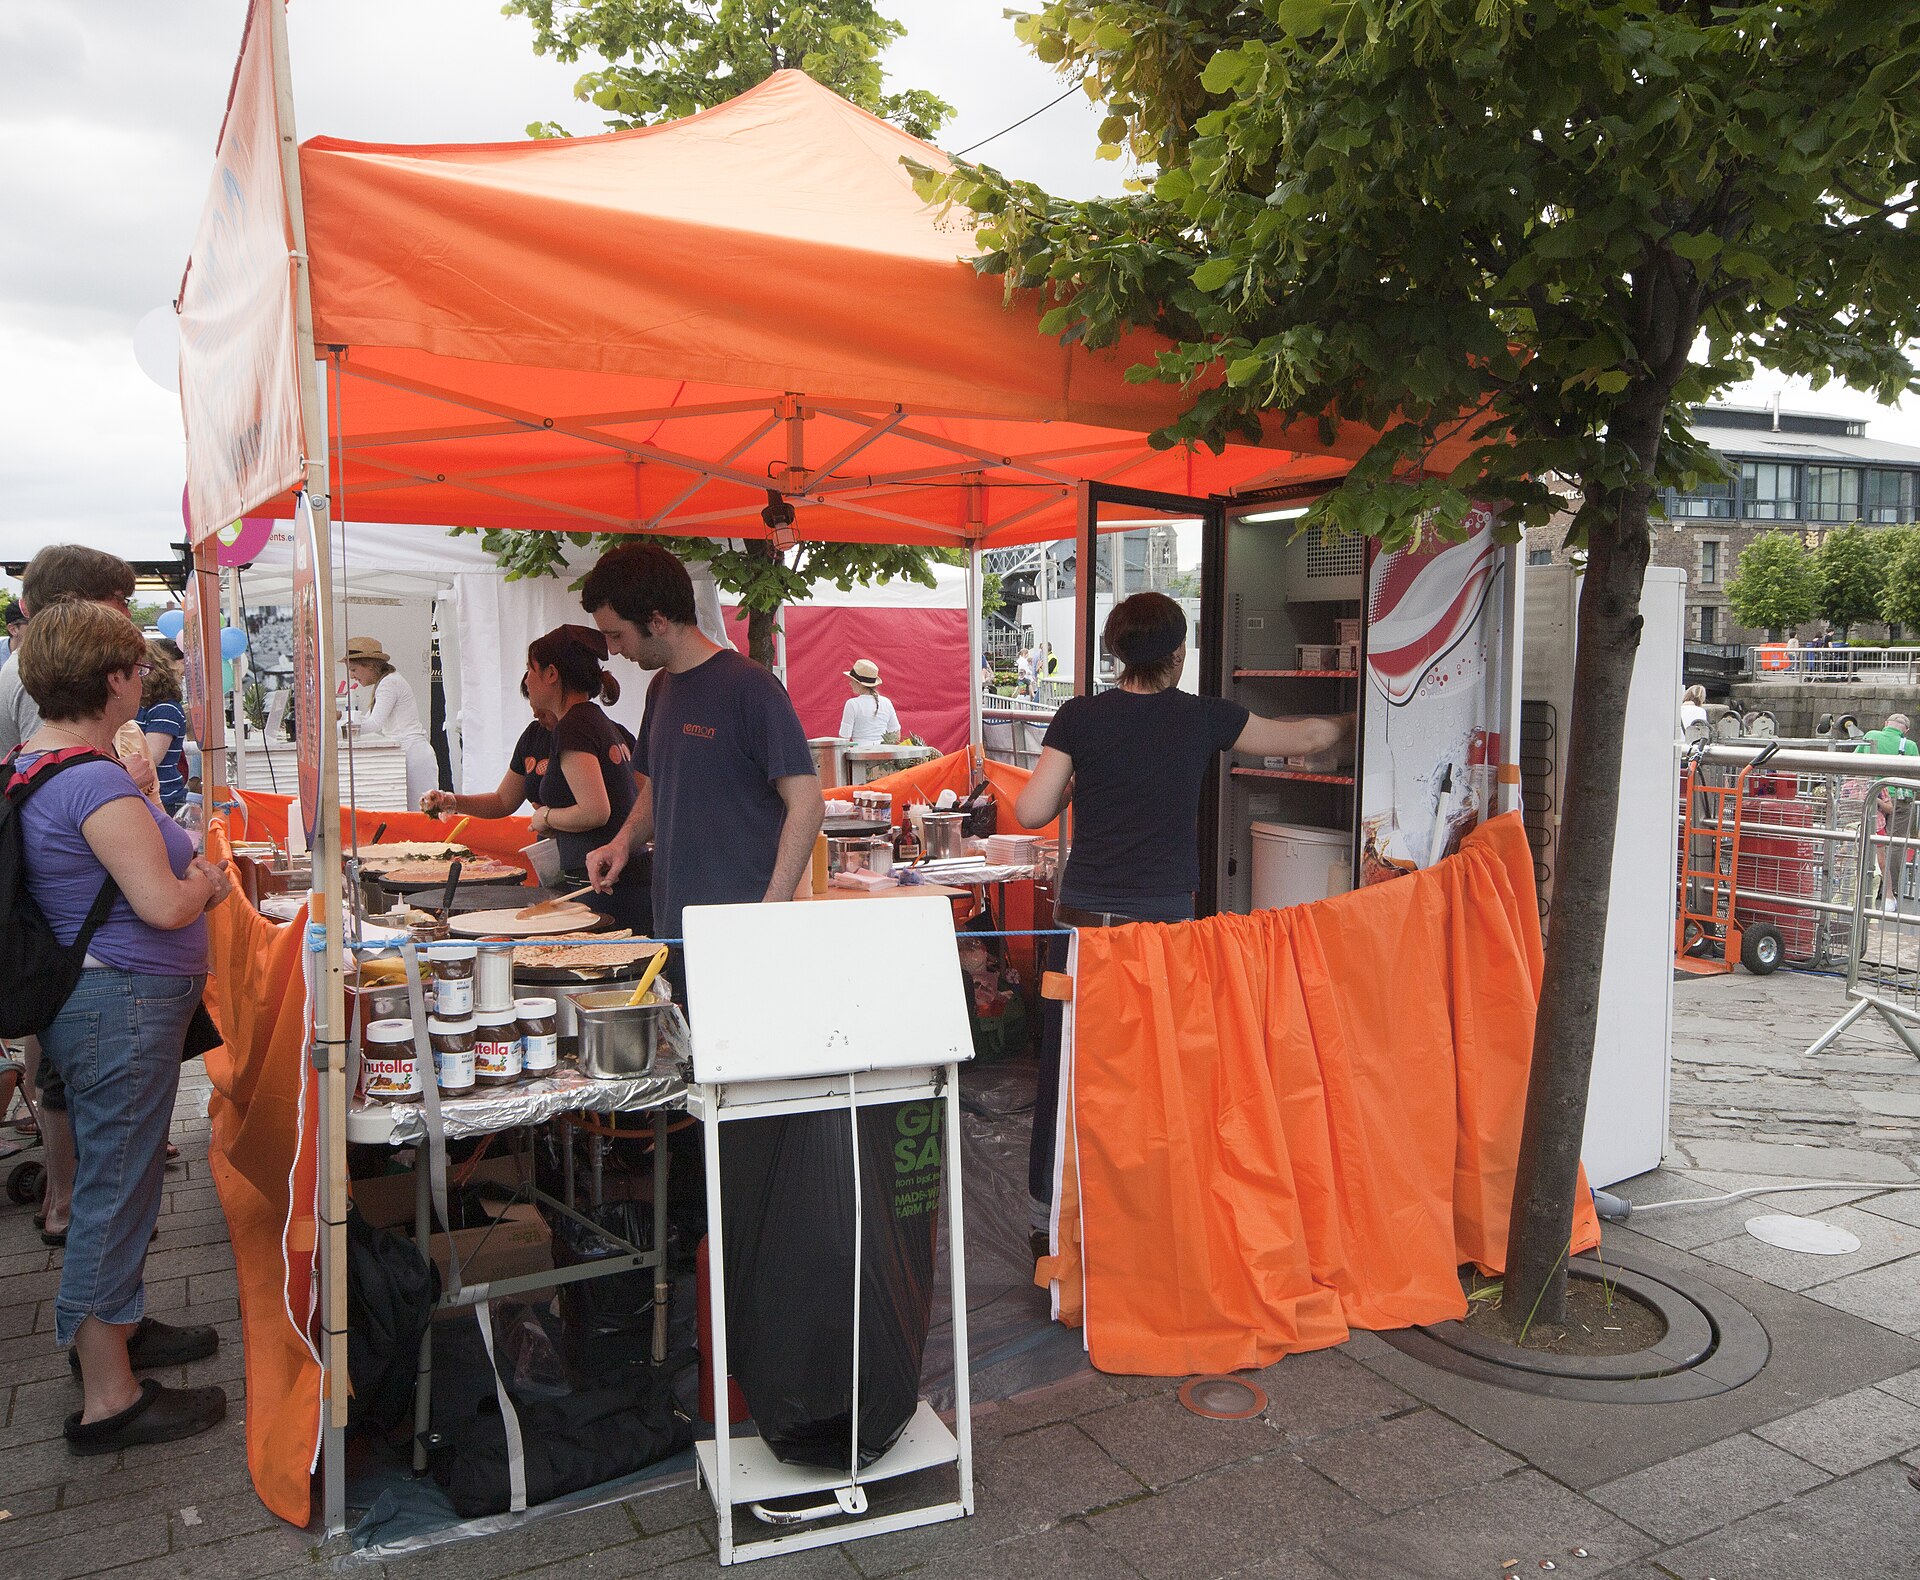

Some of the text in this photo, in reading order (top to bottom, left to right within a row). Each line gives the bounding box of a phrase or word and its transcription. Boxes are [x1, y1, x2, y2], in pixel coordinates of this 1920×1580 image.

[474, 1041, 509, 1055] utella
[364, 1060, 413, 1073] nutella
[894, 1136, 941, 1173] SA
[896, 1202, 923, 1218] FARM
